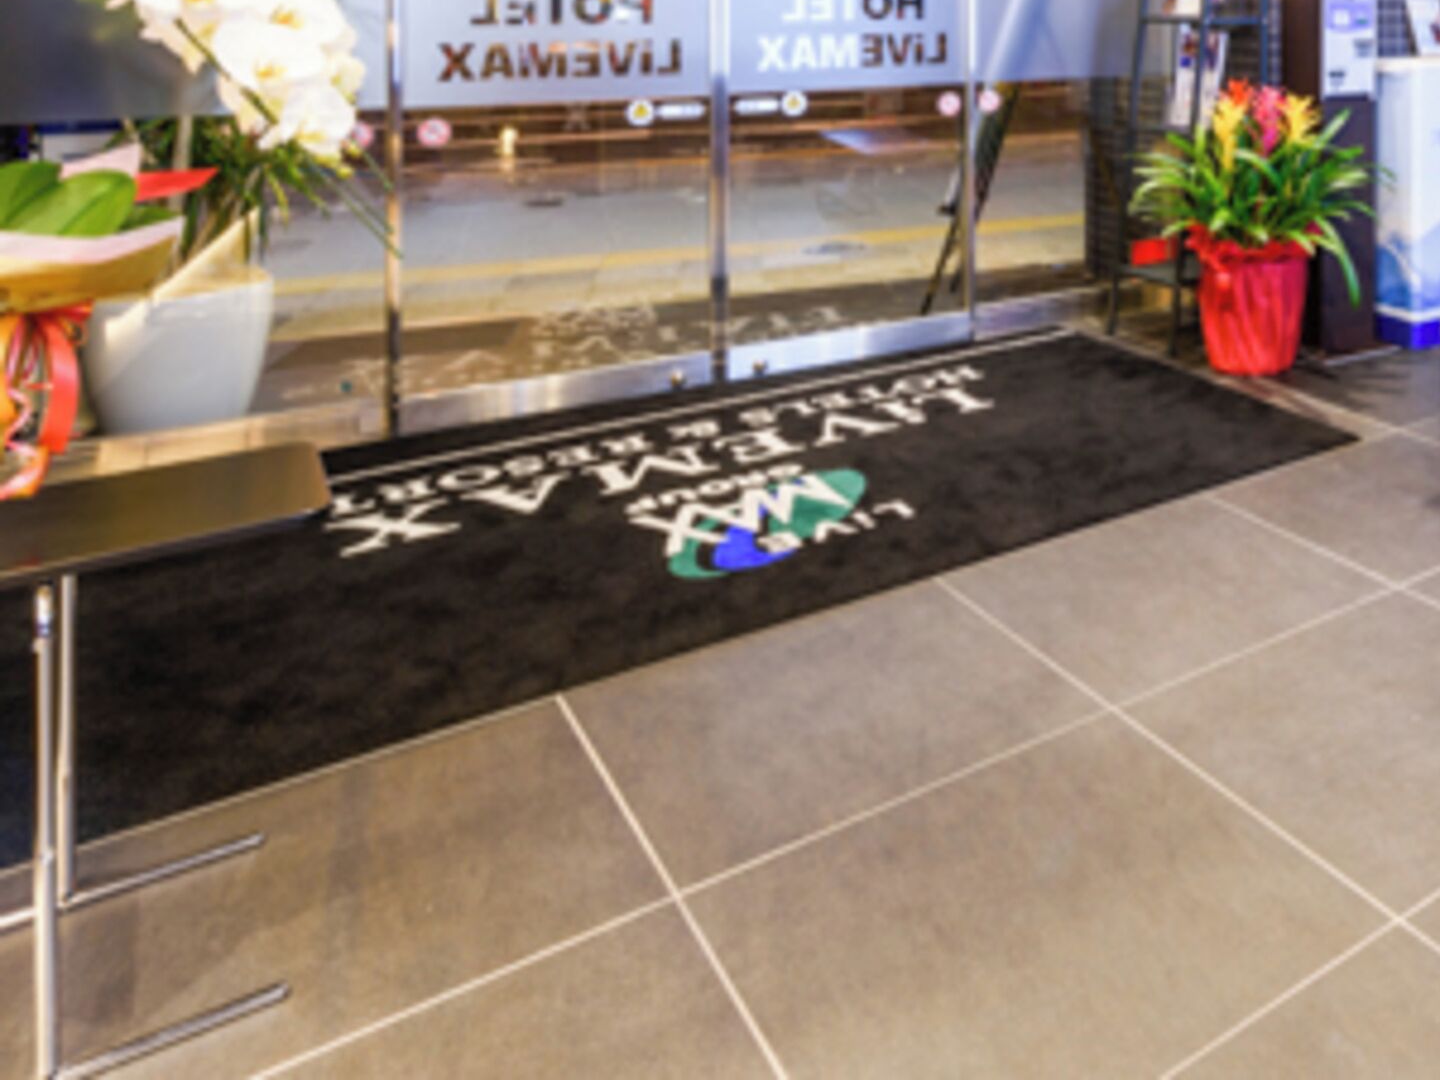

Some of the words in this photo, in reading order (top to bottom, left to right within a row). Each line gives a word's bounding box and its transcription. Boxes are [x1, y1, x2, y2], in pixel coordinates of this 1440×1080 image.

[738, 365, 985, 424] HOTELS
[667, 420, 720, 440] &
[624, 464, 803, 514] GROUP
[628, 473, 851, 558] MAX
